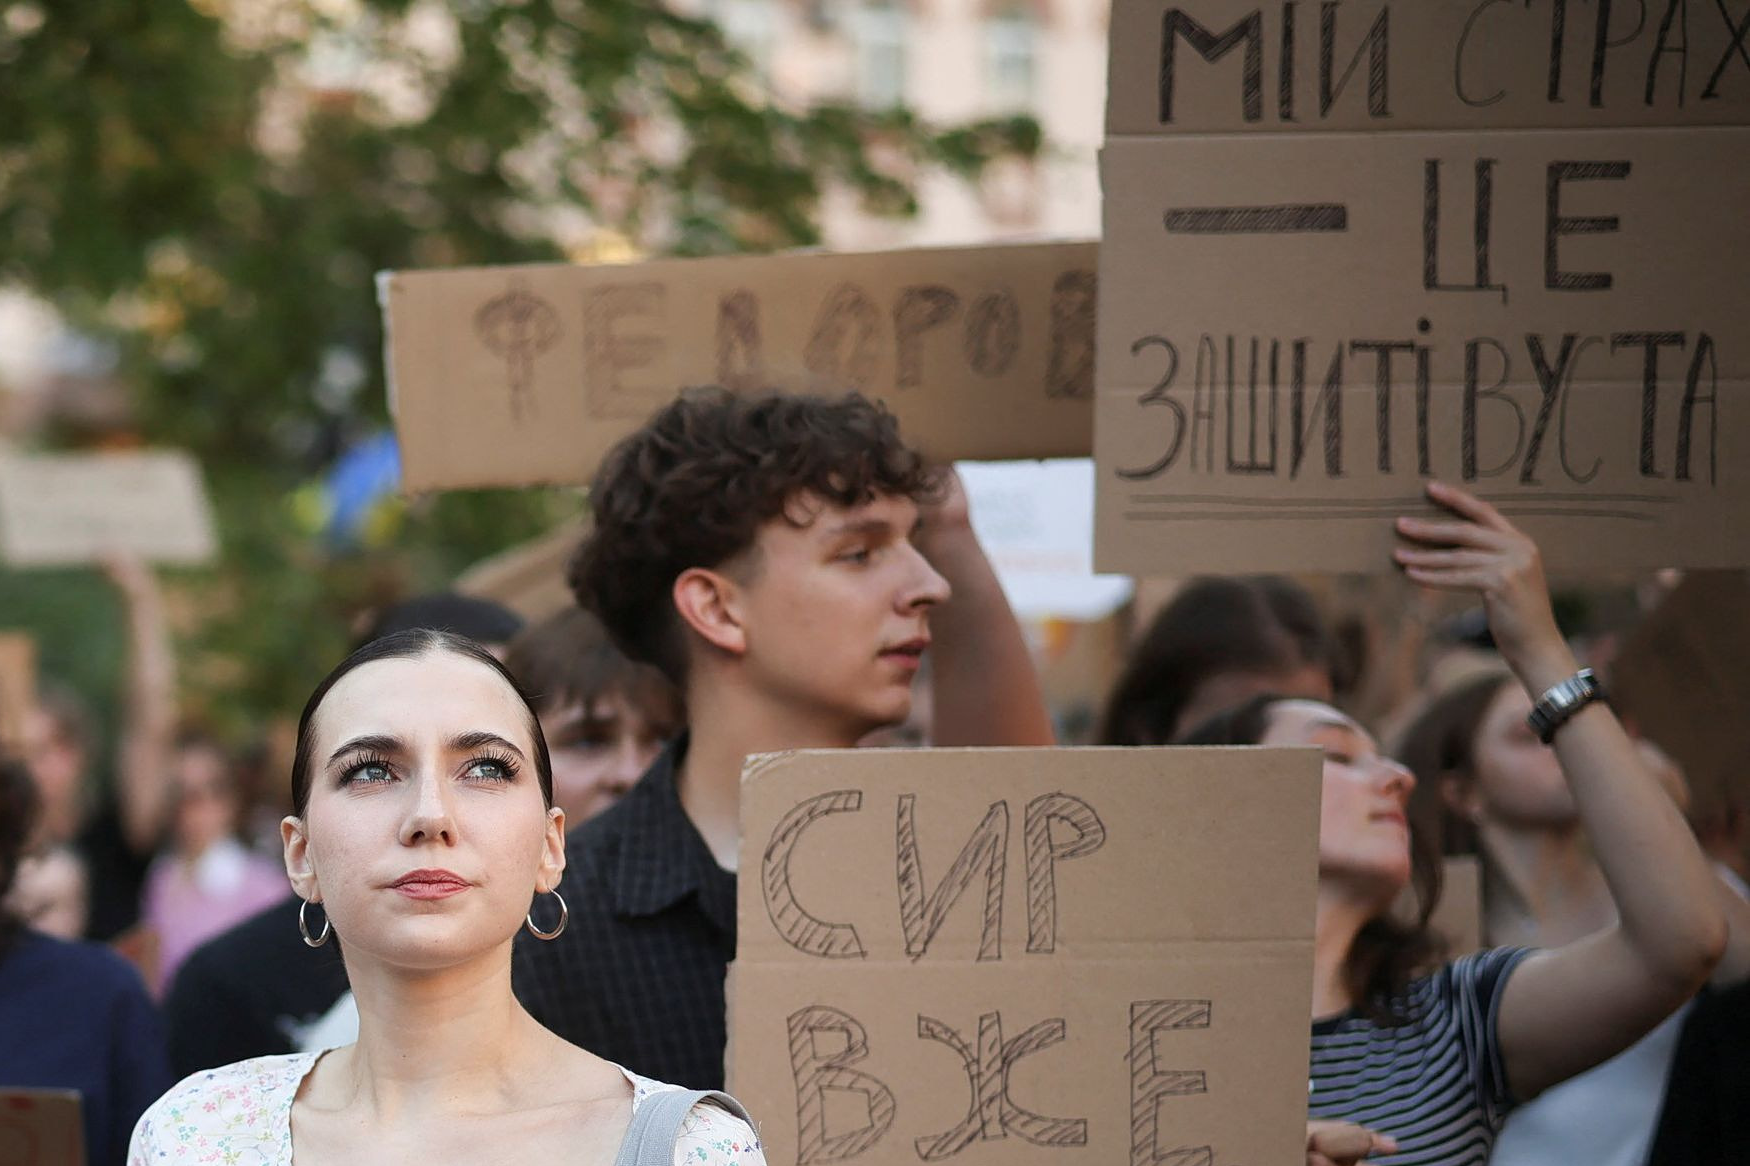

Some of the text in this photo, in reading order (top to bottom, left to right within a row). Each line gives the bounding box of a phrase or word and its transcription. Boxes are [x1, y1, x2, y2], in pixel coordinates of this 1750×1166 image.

[1422, 158, 1633, 306] ЦЕ
[1461, 330, 1718, 487] ВУСТА
[762, 789, 1106, 962] СИР
